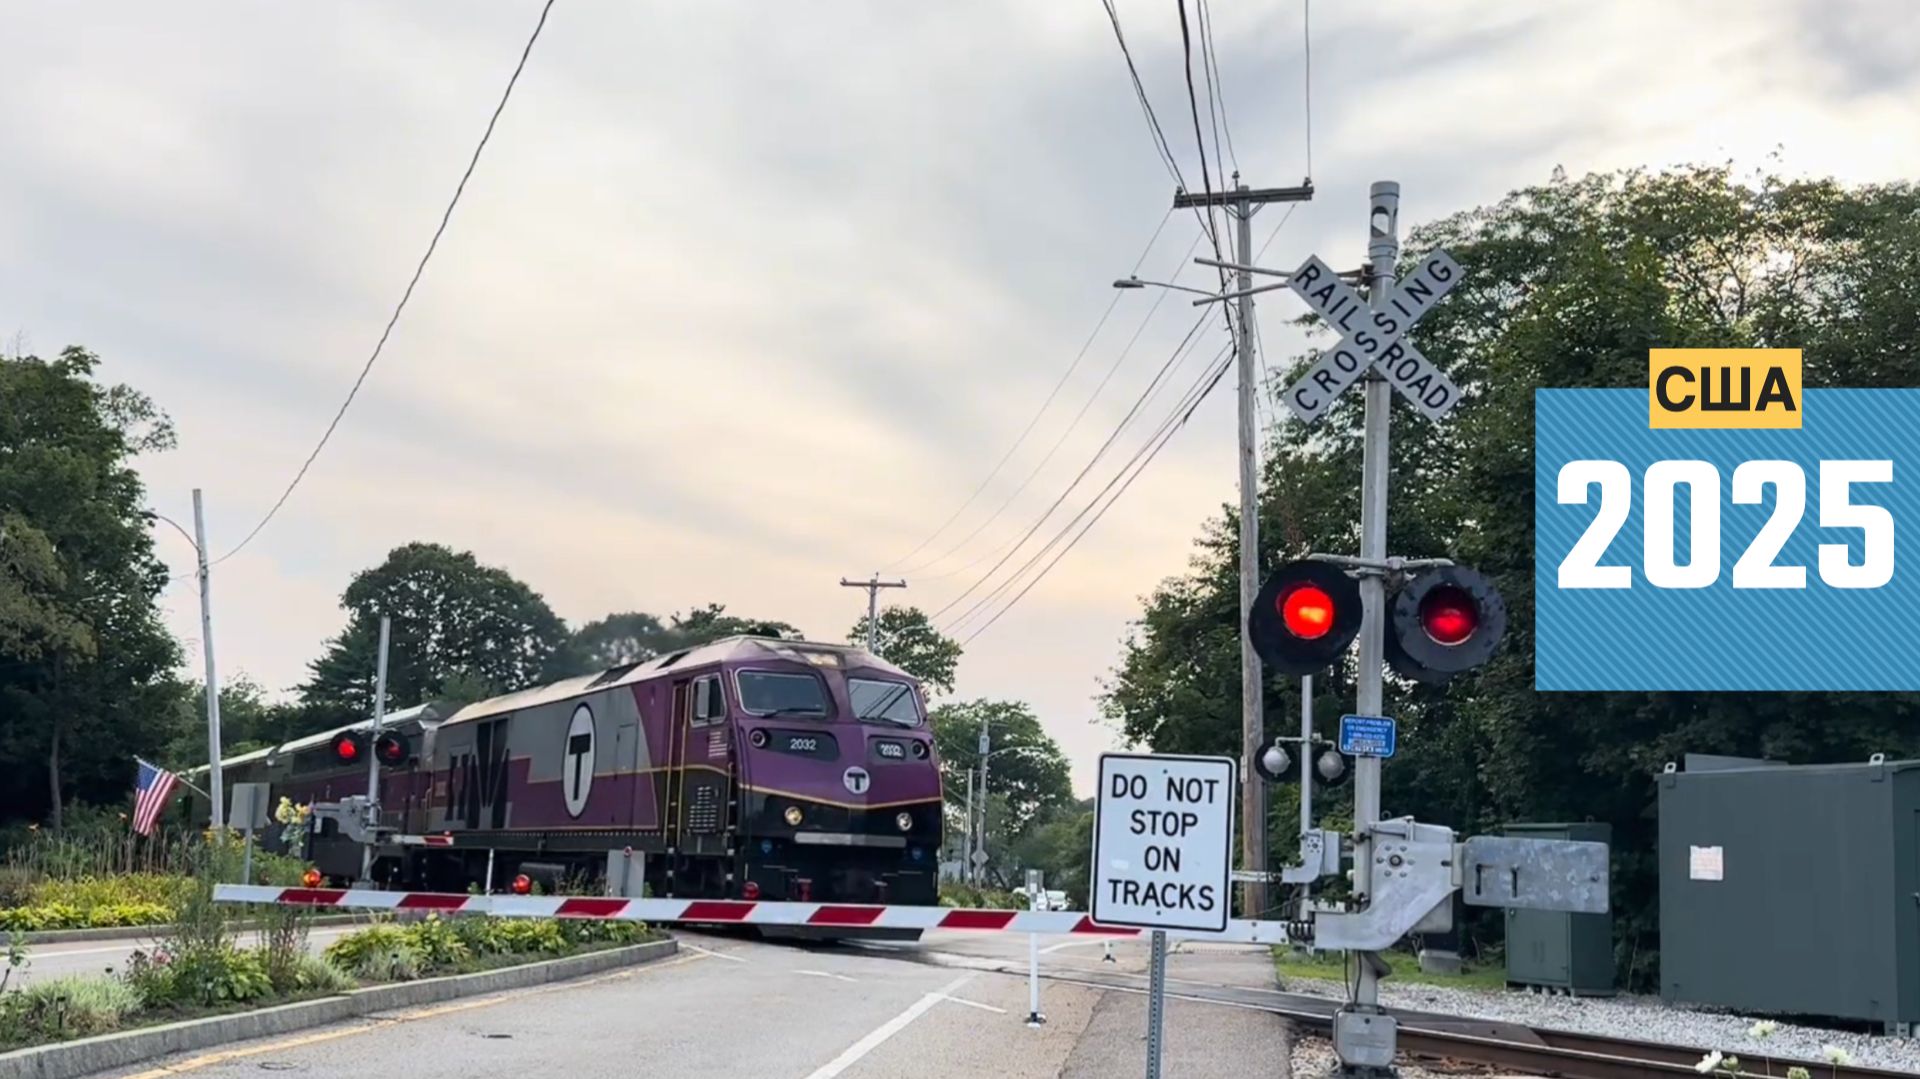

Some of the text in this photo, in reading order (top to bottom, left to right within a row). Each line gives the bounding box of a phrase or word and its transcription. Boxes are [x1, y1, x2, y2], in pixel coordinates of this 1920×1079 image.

[1295, 259, 1452, 411] CROSSING
[1295, 263, 1449, 409] RAIL ROAD
[790, 738, 817, 751] 2032
[569, 733, 591, 801] T
[1111, 773, 1219, 804] DO NOT
[1130, 809, 1198, 837] STOP
[1144, 845, 1180, 873] ON
[1108, 878, 1215, 912] TRACKS
